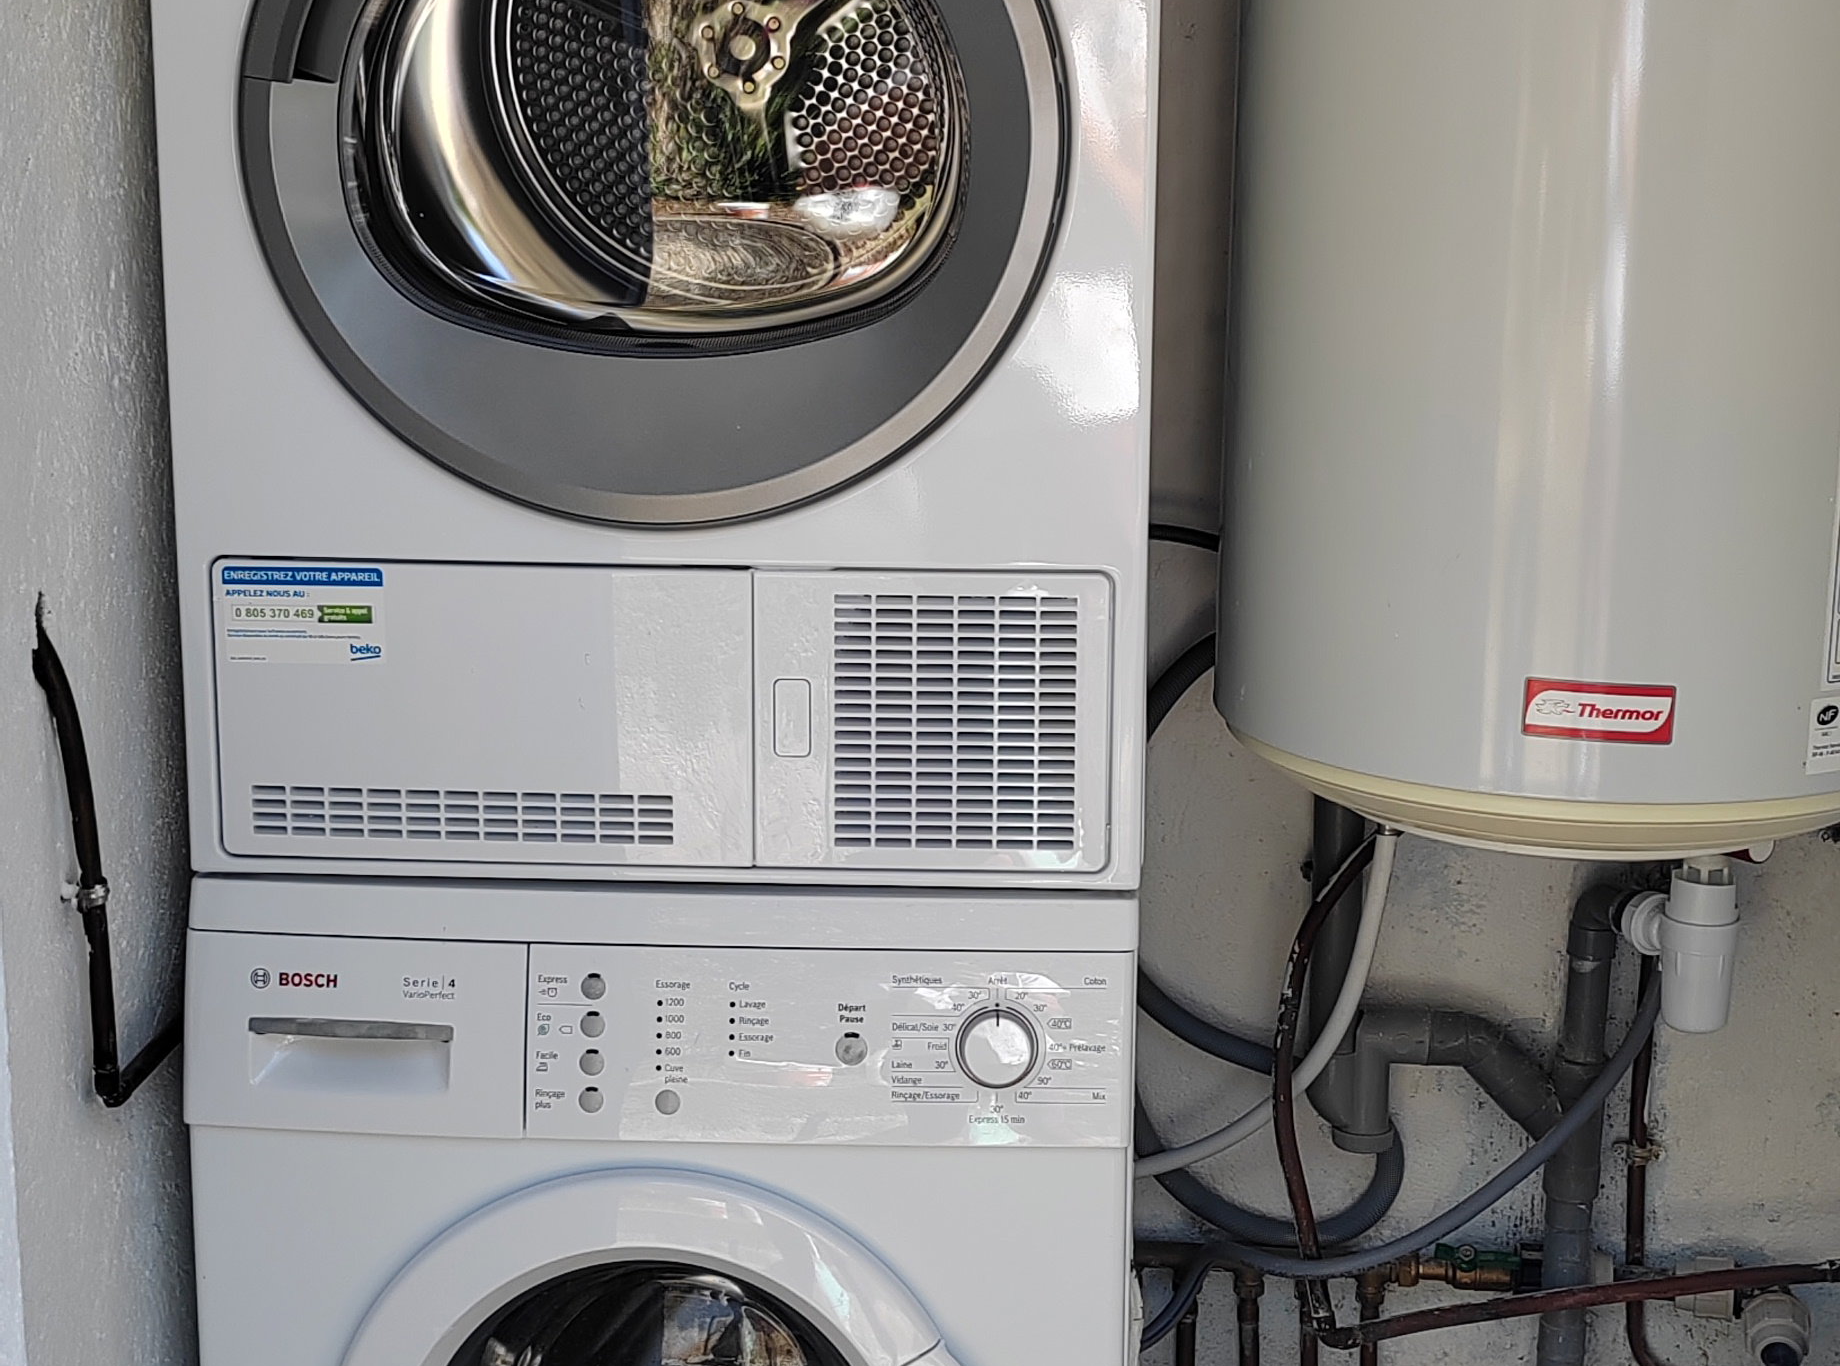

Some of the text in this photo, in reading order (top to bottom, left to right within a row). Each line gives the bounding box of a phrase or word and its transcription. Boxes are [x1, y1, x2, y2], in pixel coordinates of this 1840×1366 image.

[224, 571, 380, 582] ENREGISTREZ VOTRE APPAREIL
[235, 608, 314, 618] 0 805 370 469
[350, 644, 381, 655] beko
[1578, 703, 1664, 721] Thermor
[1819, 709, 1836, 722] NF
[279, 973, 338, 988] BOSCH
[403, 976, 456, 988] Serie 4
[538, 975, 567, 984] Express
[892, 975, 942, 985] Synthétiques
[988, 976, 1007, 984] Arrêt
[656, 980, 690, 990] Essorage
[729, 982, 749, 991] Cycle
[403, 990, 455, 1000] VarioPerfect
[739, 1000, 766, 1009] Lavage
[838, 1003, 866, 1013] Départ
[537, 1013, 551, 1021] Eco
[664, 1015, 684, 1023] 1000
[739, 1016, 769, 1026] Rinçage
[840, 1015, 864, 1023] Pause
[892, 1023, 939, 1031] Délicat/Soie
[739, 1033, 773, 1043] Essorage
[928, 1042, 947, 1050] Froid
[1070, 1044, 1106, 1053] Prélavage
[536, 1051, 558, 1059] Facile
[665, 1047, 681, 1055] 600
[665, 1064, 684, 1072] Cuve
[665, 1074, 688, 1083] pleine
[892, 1076, 922, 1084] Vidange
[536, 1089, 565, 1099] Rinçage
[892, 1091, 960, 1101] Rinçage/Essorage
[535, 1101, 551, 1110] plus
[969, 1115, 1025, 1124] Express 15 min
